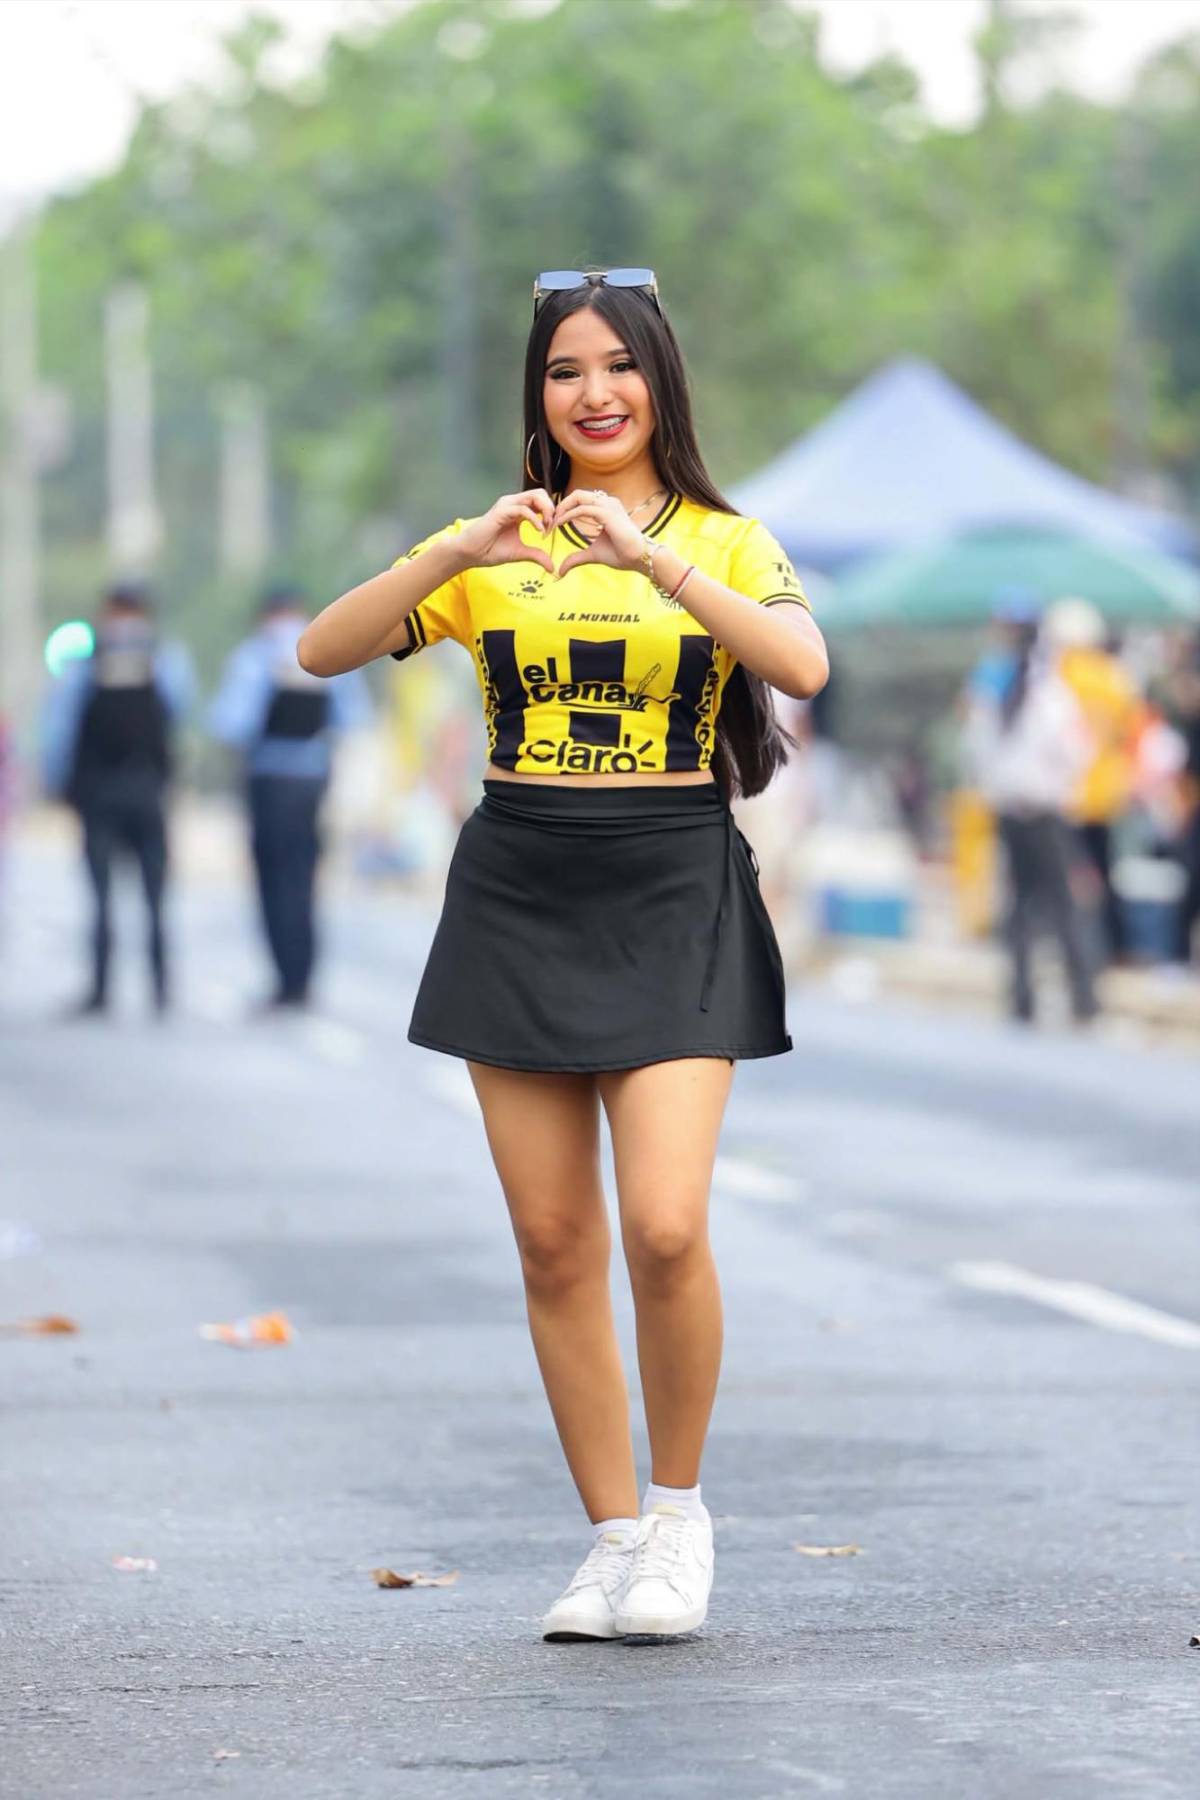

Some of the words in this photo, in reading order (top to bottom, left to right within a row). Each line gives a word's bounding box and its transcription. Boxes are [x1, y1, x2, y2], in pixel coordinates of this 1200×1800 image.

[558, 612, 576, 621] LA
[578, 613, 641, 623] MUNDIAL
[523, 657, 557, 684] el
[526, 739, 638, 773] Claro
